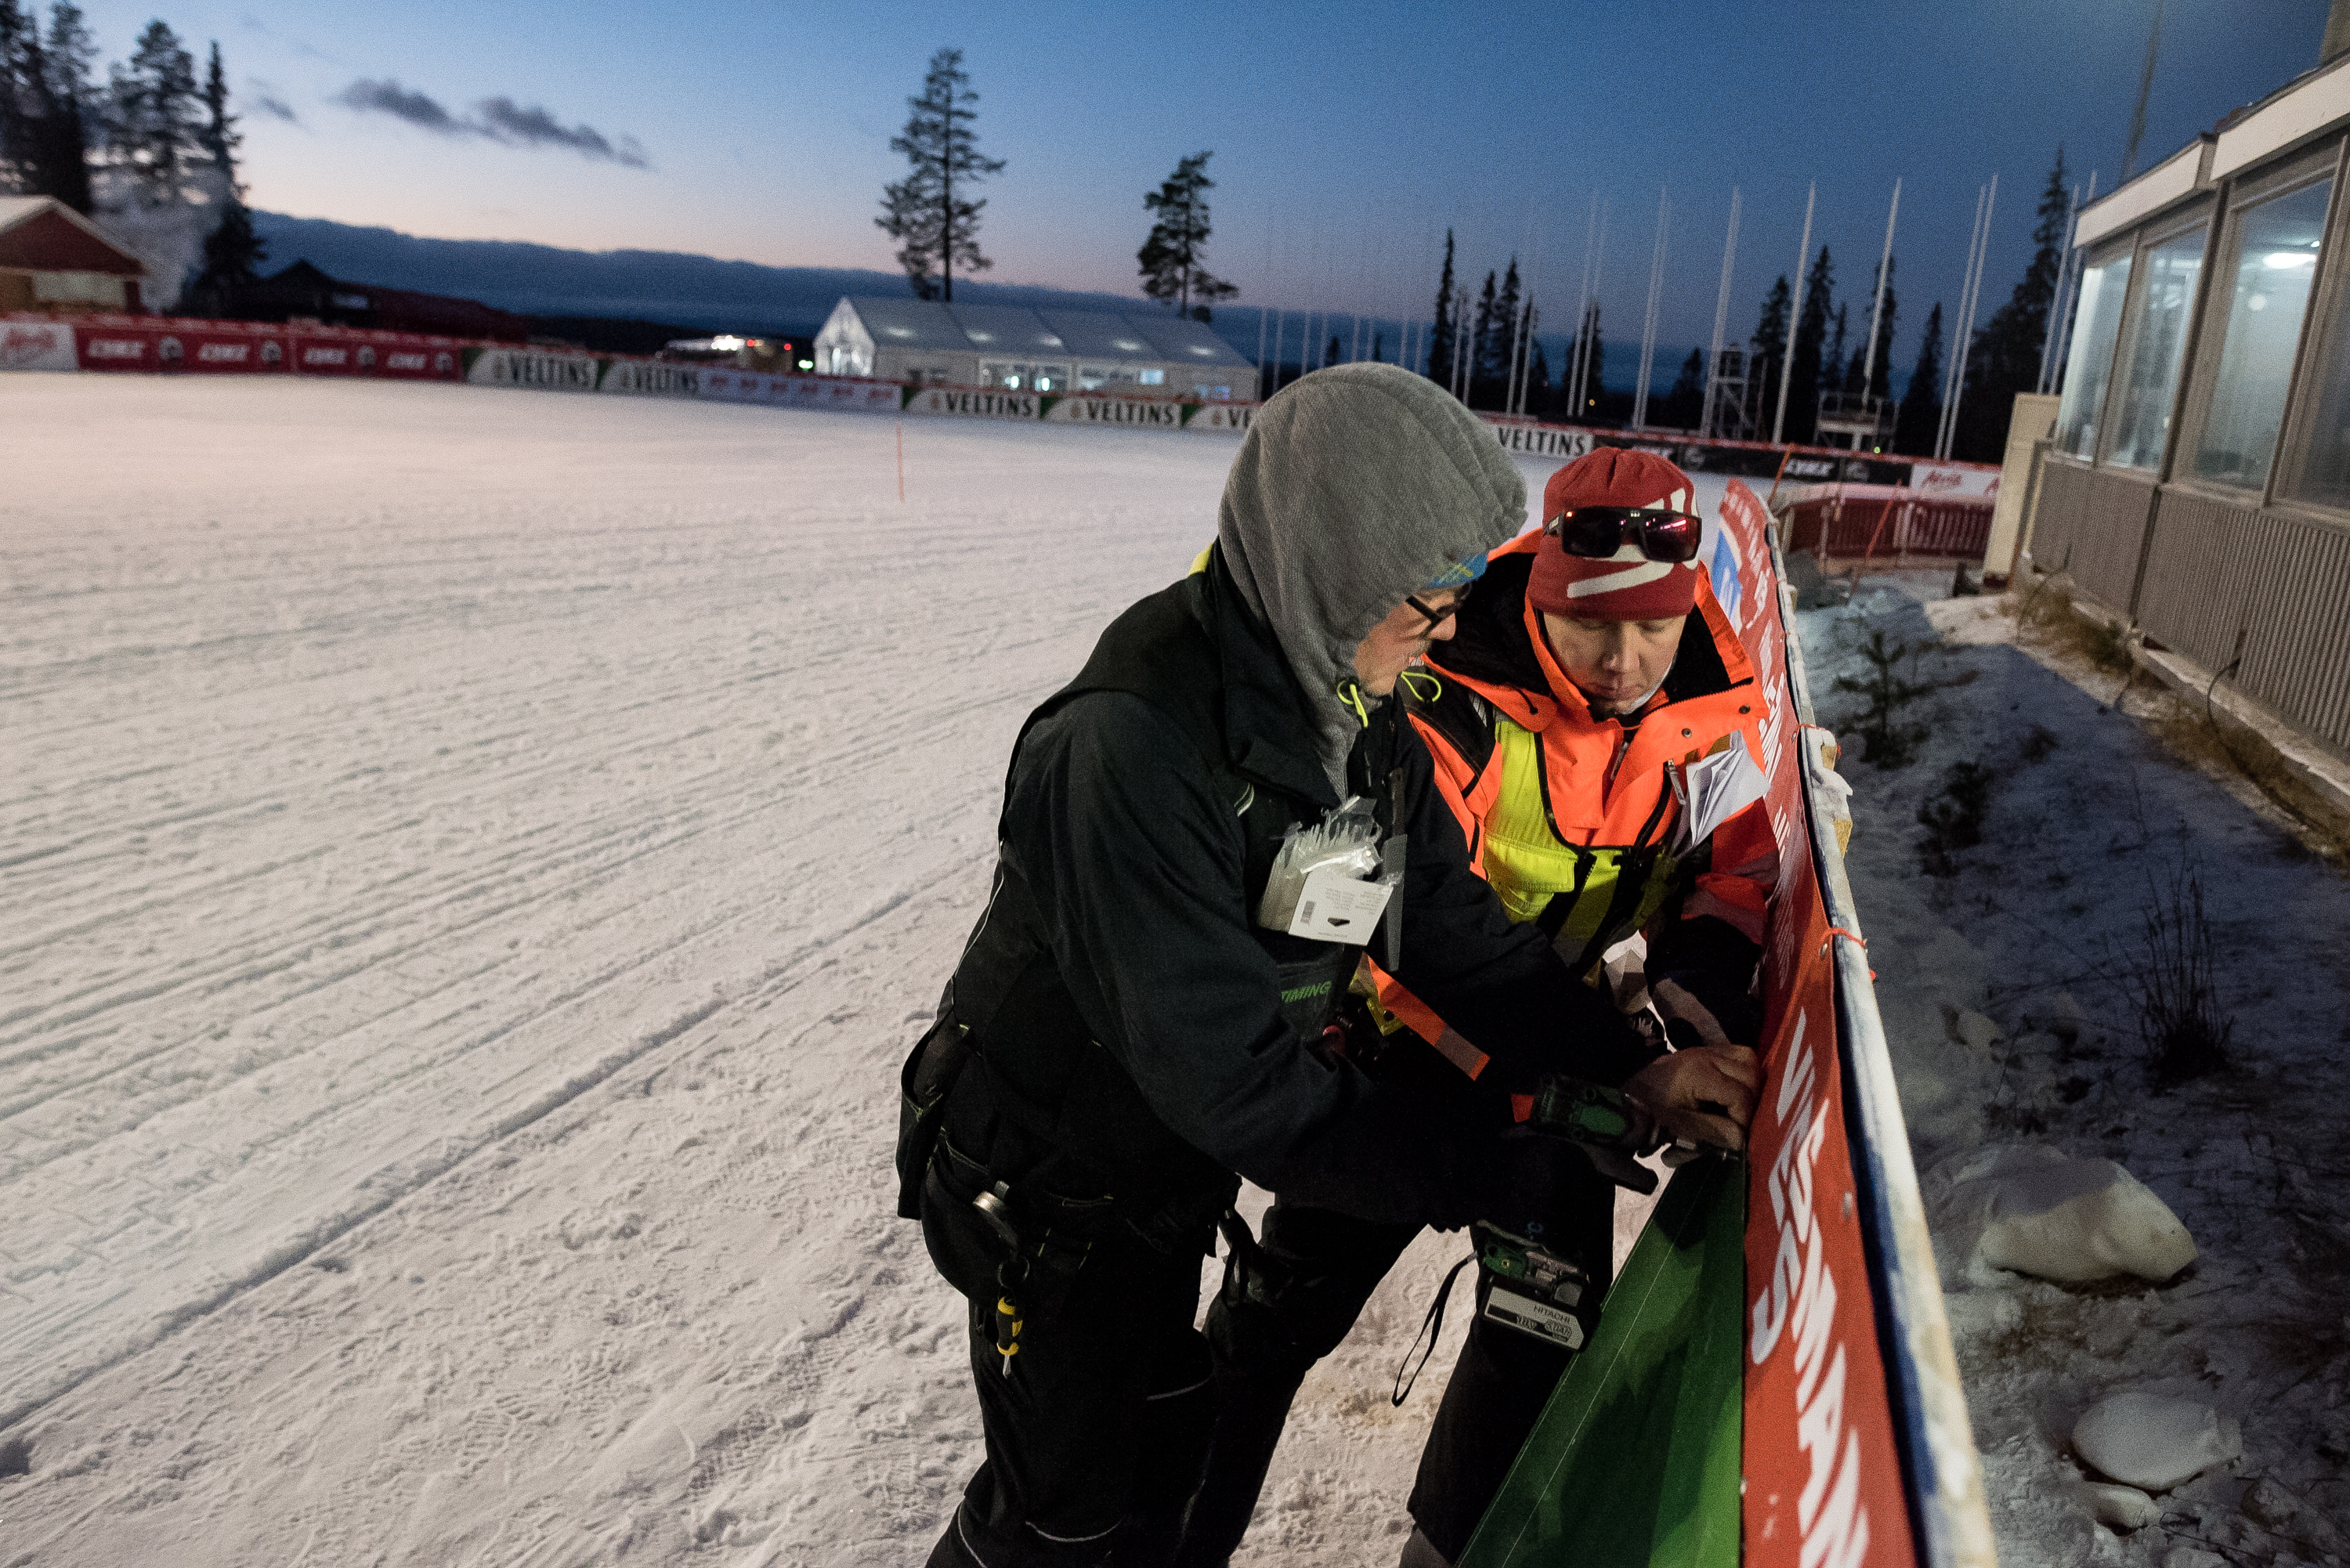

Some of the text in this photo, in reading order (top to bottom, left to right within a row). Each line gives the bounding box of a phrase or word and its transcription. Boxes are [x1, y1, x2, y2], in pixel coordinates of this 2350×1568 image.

[945, 392, 1032, 417] VELTINS
[1086, 401, 1173, 425] VELTINS
[1498, 427, 1584, 457] VELTINS
[1281, 981, 1332, 1003] TIMING
[1533, 1305, 1571, 1324] HITACHI
